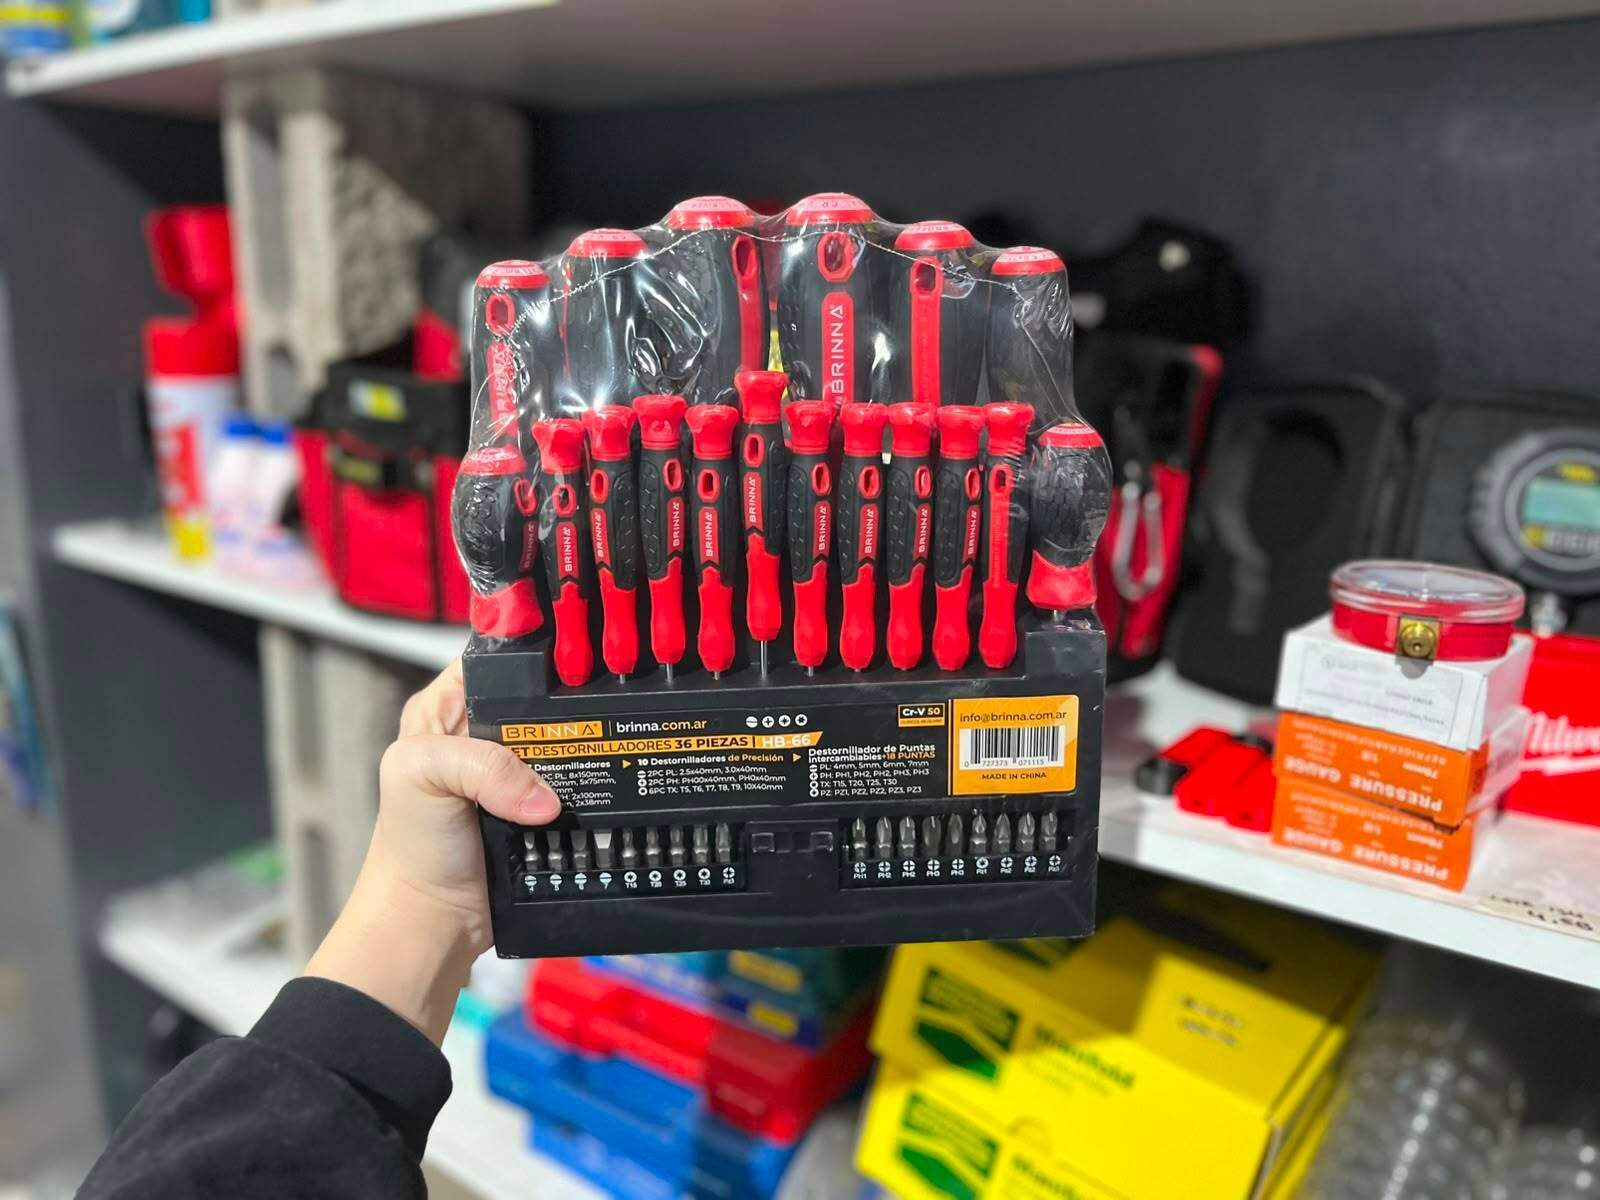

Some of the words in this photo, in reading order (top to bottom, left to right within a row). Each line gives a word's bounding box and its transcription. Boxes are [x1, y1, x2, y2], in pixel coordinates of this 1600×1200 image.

[829, 304, 845, 394] BRINNA
[748, 478, 757, 522] BRINNA
[595, 513, 606, 557] BRINNA
[672, 501, 680, 547] BRINNA
[705, 513, 713, 556] BRINNA
[819, 506, 827, 550] BRINNA
[865, 508, 874, 553] BRINNA
[919, 508, 928, 552] BRINNA
[968, 510, 977, 554] BRINNA
[563, 527, 572, 571] BRINNA
[616, 720, 707, 733] brinna.com.ar
[902, 707, 926, 716] Cr-V
[960, 711, 1067, 723] info@brinna.com.ar
[506, 724, 595, 738] BRINNA
[511, 747, 529, 757] ET
[533, 740, 672, 756] DESTORNILLADORES
[675, 739, 692, 749] 36
[696, 736, 748, 748] PIEZAS
[762, 734, 810, 748] HB-66
[637, 758, 648, 766] 10
[651, 755, 727, 765] Destornilladores
[727, 753, 740, 761] de
[741, 753, 784, 762] Precisión
[808, 745, 881, 756] Destornillador
[883, 744, 897, 752] de
[899, 743, 936, 752] Puntas
[898, 751, 936, 759] PUNTAS
[534, 761, 611, 771] Destornilladores
[1020, 771, 1047, 779] CHINA
[1283, 755, 1342, 783] GAUGE
[1350, 773, 1443, 812] PRESSURE
[1282, 827, 1343, 854] GAUGE
[1352, 844, 1449, 881] PRESSURE
